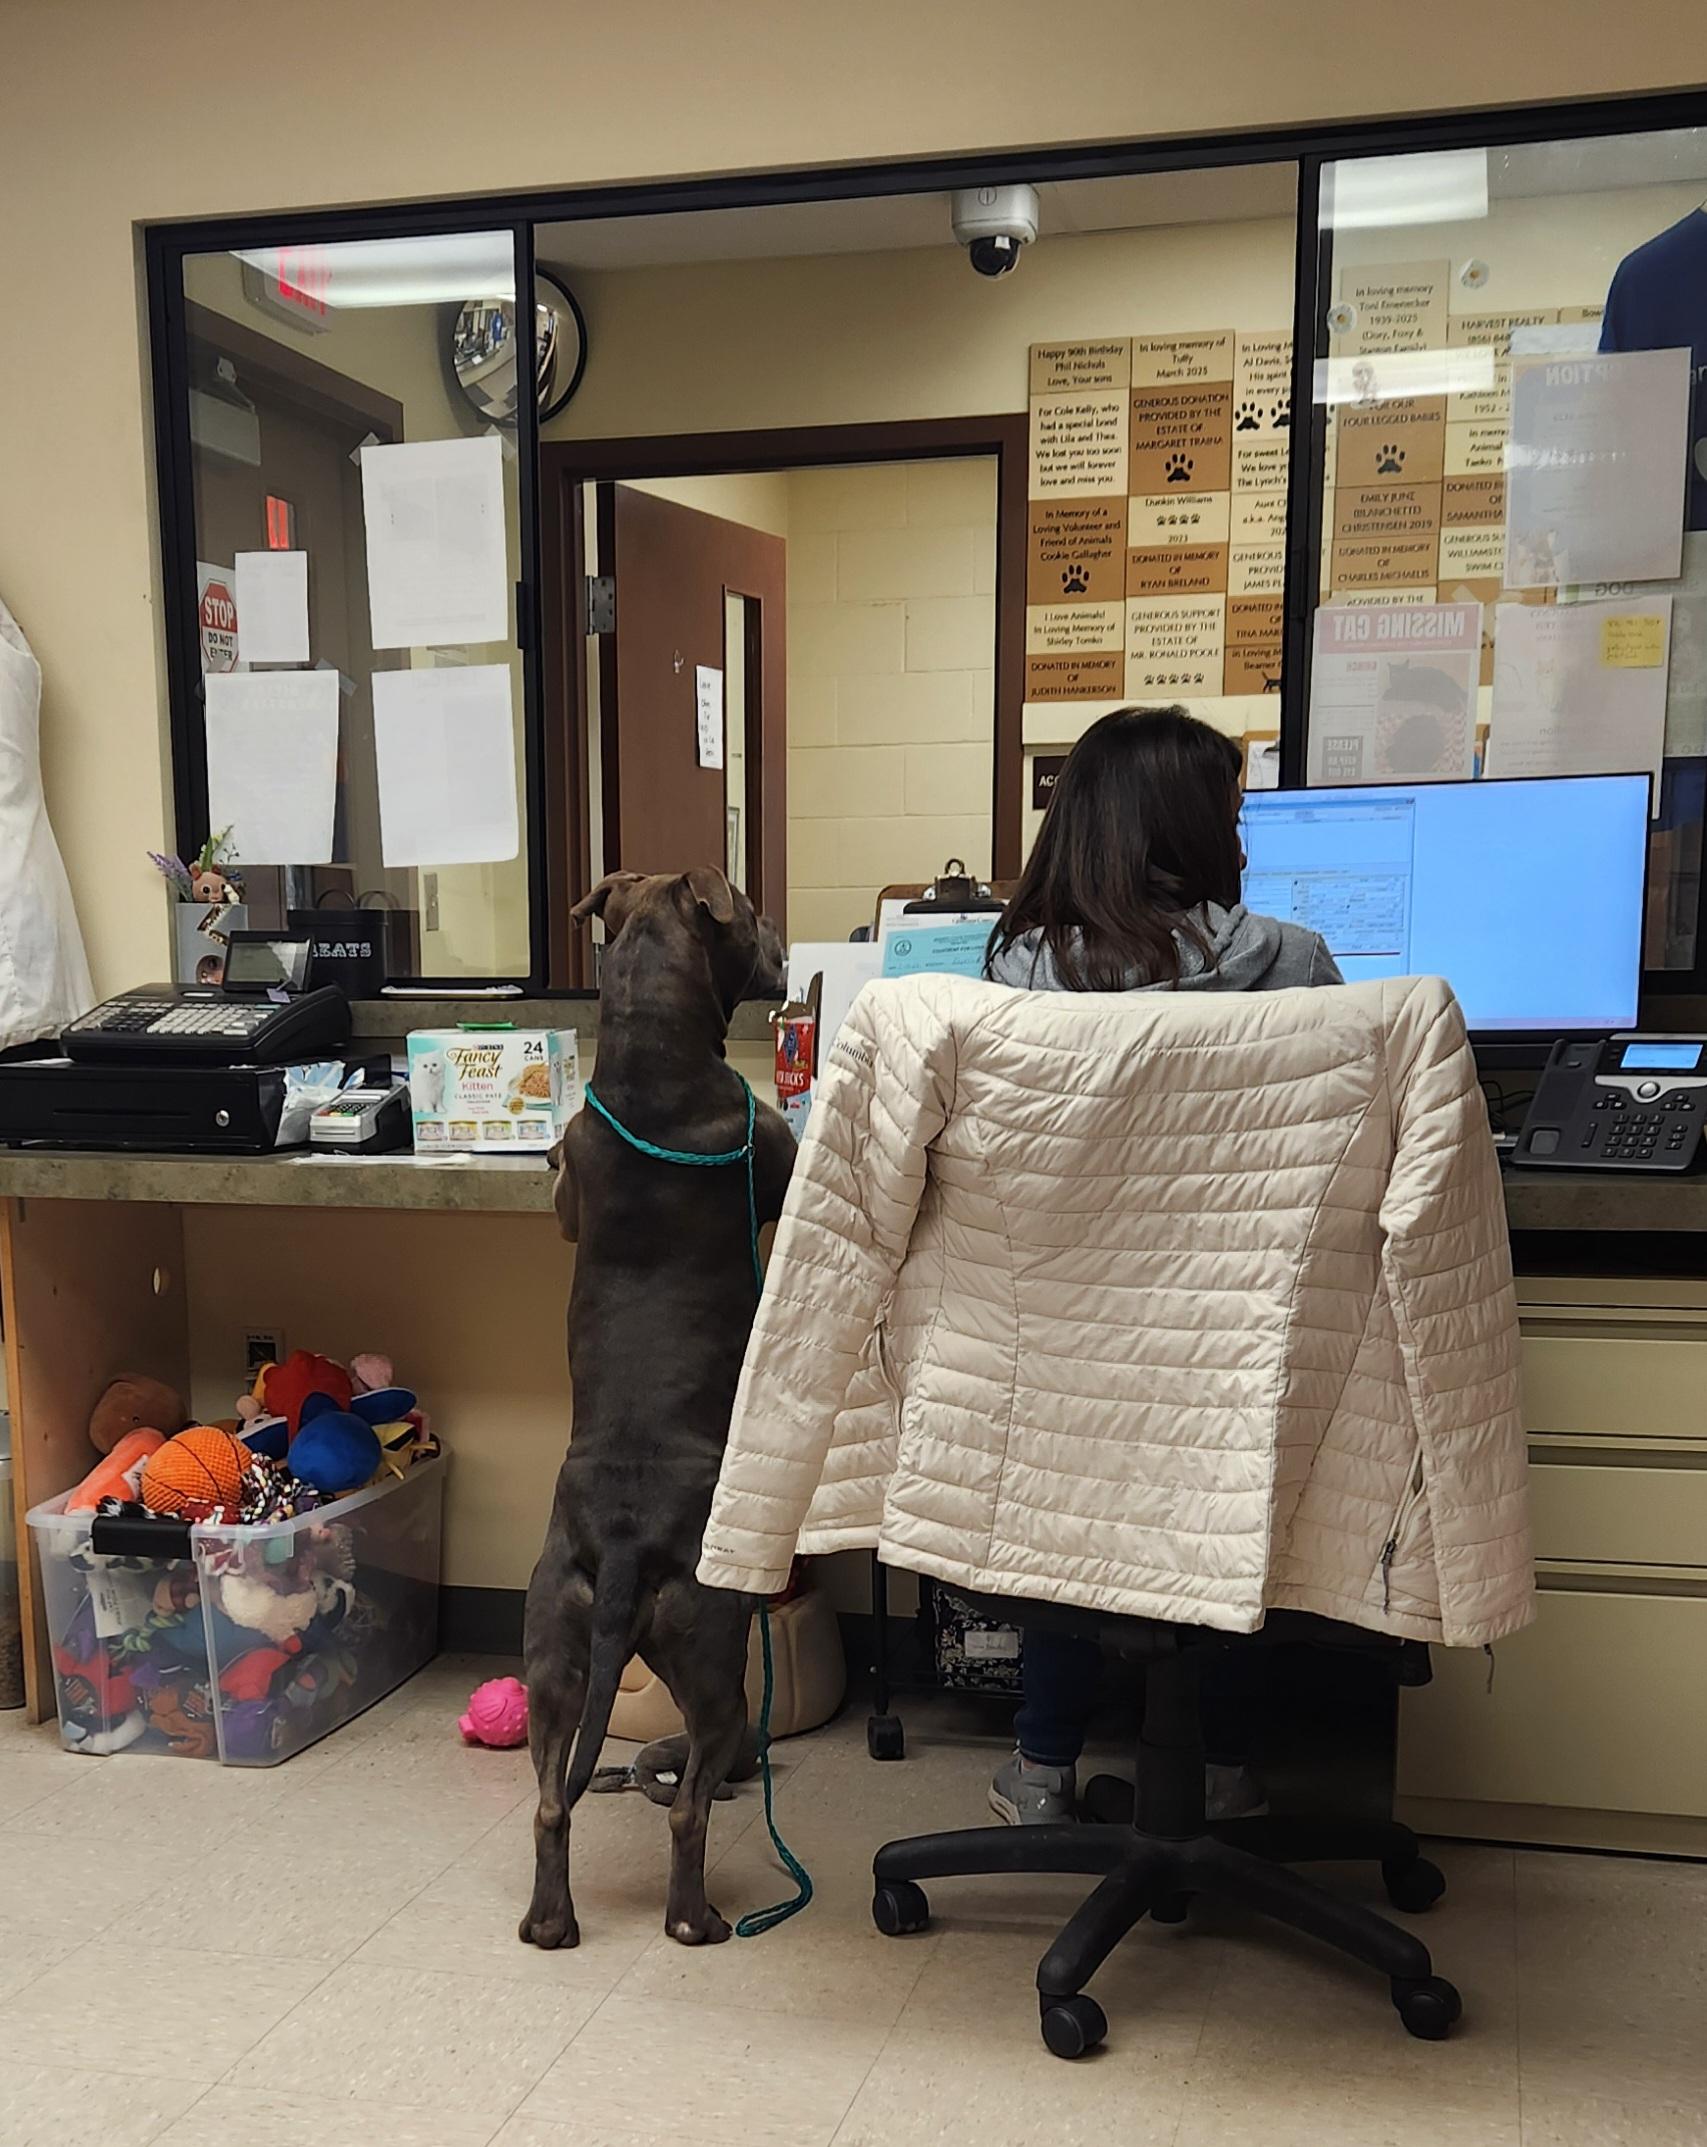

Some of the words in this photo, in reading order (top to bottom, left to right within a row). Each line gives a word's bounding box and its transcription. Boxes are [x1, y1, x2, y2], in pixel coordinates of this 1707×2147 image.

[1178, 341, 1215, 351] memory
[1252, 342, 1282, 352] Loving
[1156, 368, 1184, 378] March
[1138, 410, 1188, 422] PROVIDED
[1032, 524, 1061, 535] Loving
[204, 595, 235, 629] STOP
[313, 942, 372, 958] EATS
[523, 1041, 544, 1054] 24
[446, 1046, 502, 1064] Fancy
[458, 1062, 502, 1081] Feast
[462, 1082, 494, 1091] Kitten
